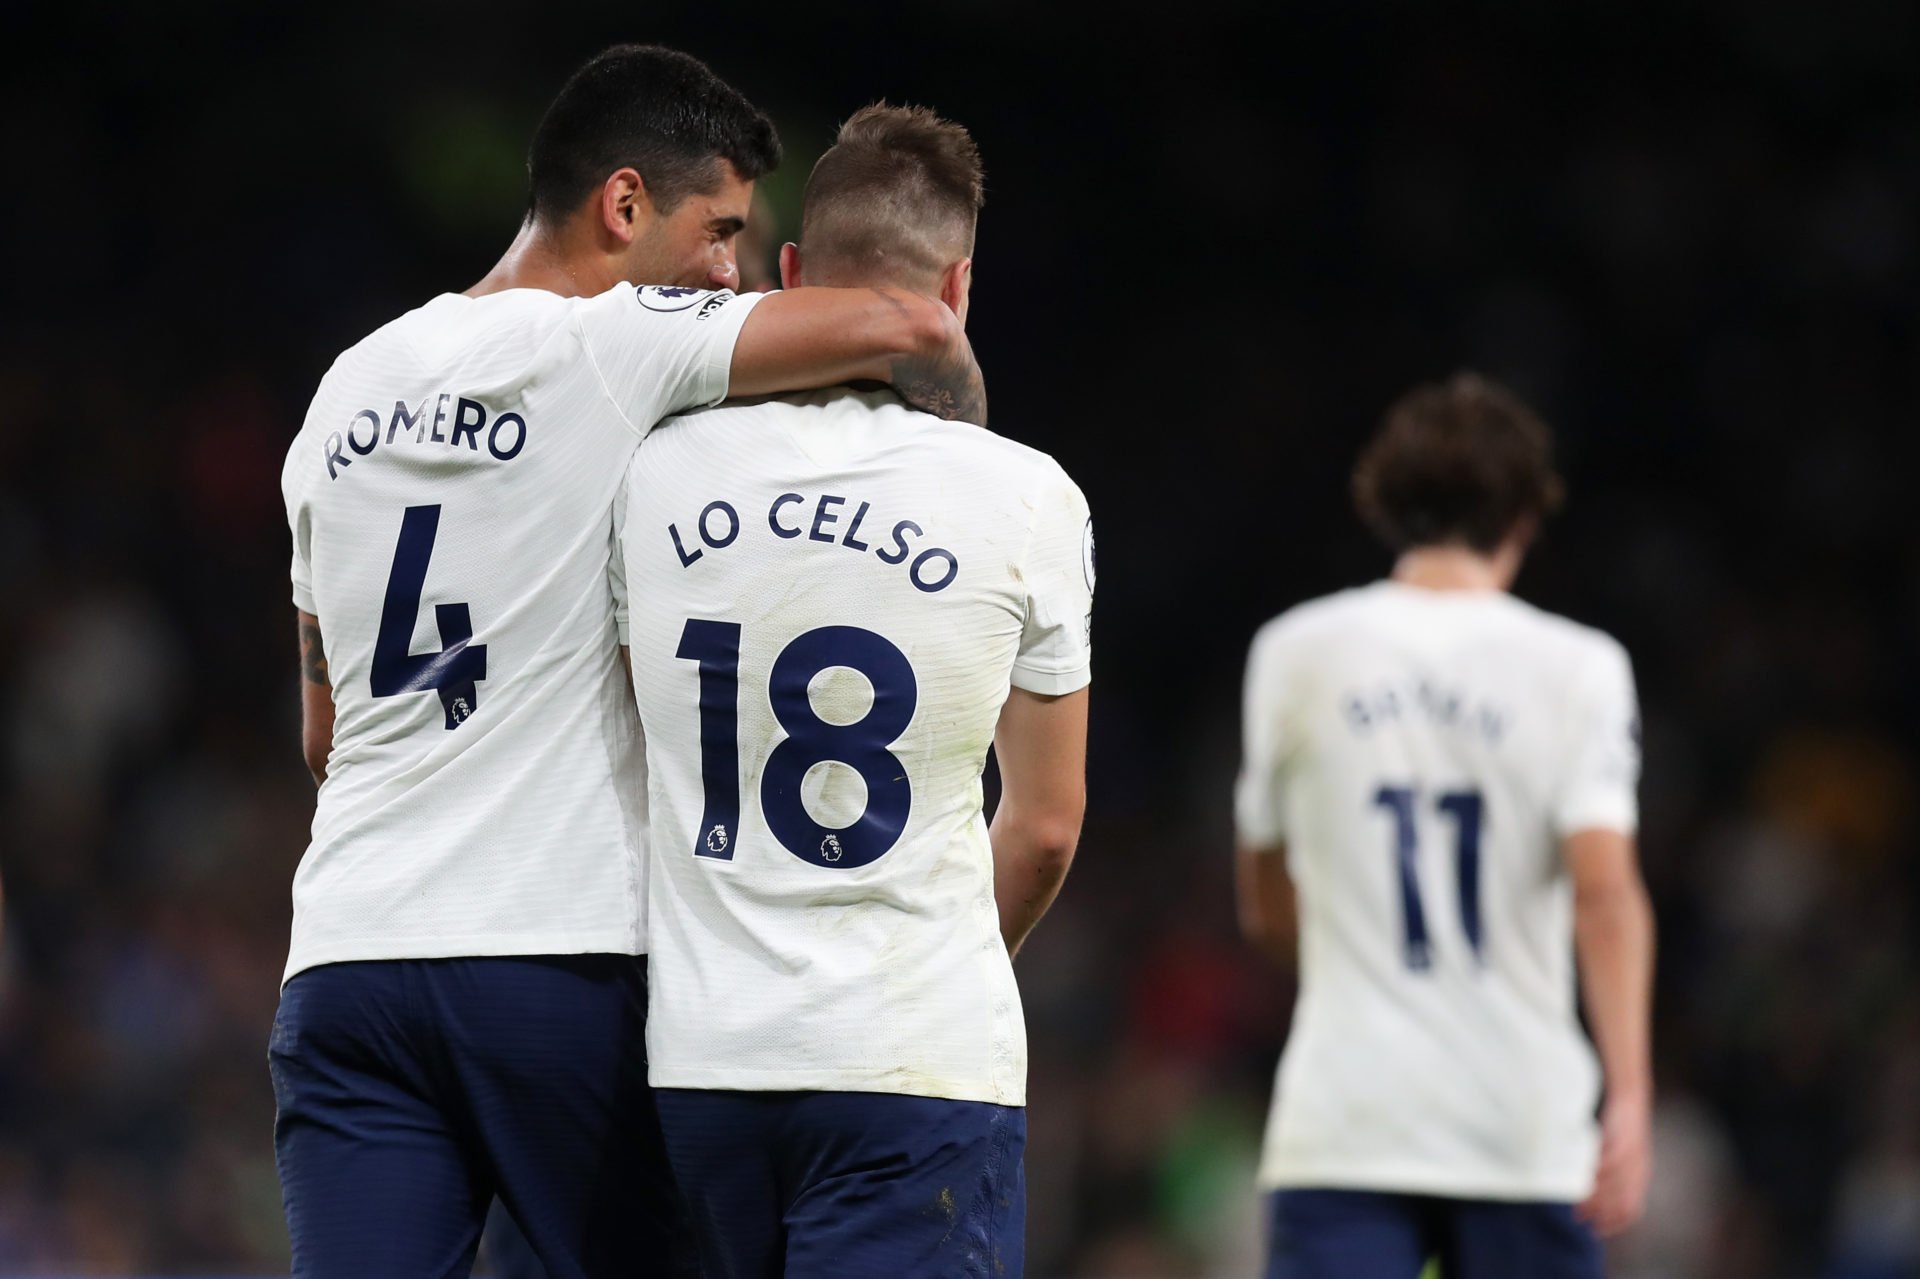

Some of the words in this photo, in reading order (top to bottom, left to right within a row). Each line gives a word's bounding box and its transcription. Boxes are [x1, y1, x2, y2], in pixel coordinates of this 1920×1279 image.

[323, 394, 527, 481] ROMERO
[370, 504, 488, 731] 4
[668, 500, 740, 568] LO
[768, 493, 959, 593] CELSO
[675, 618, 918, 870] 18
[1374, 785, 1484, 971] 11
